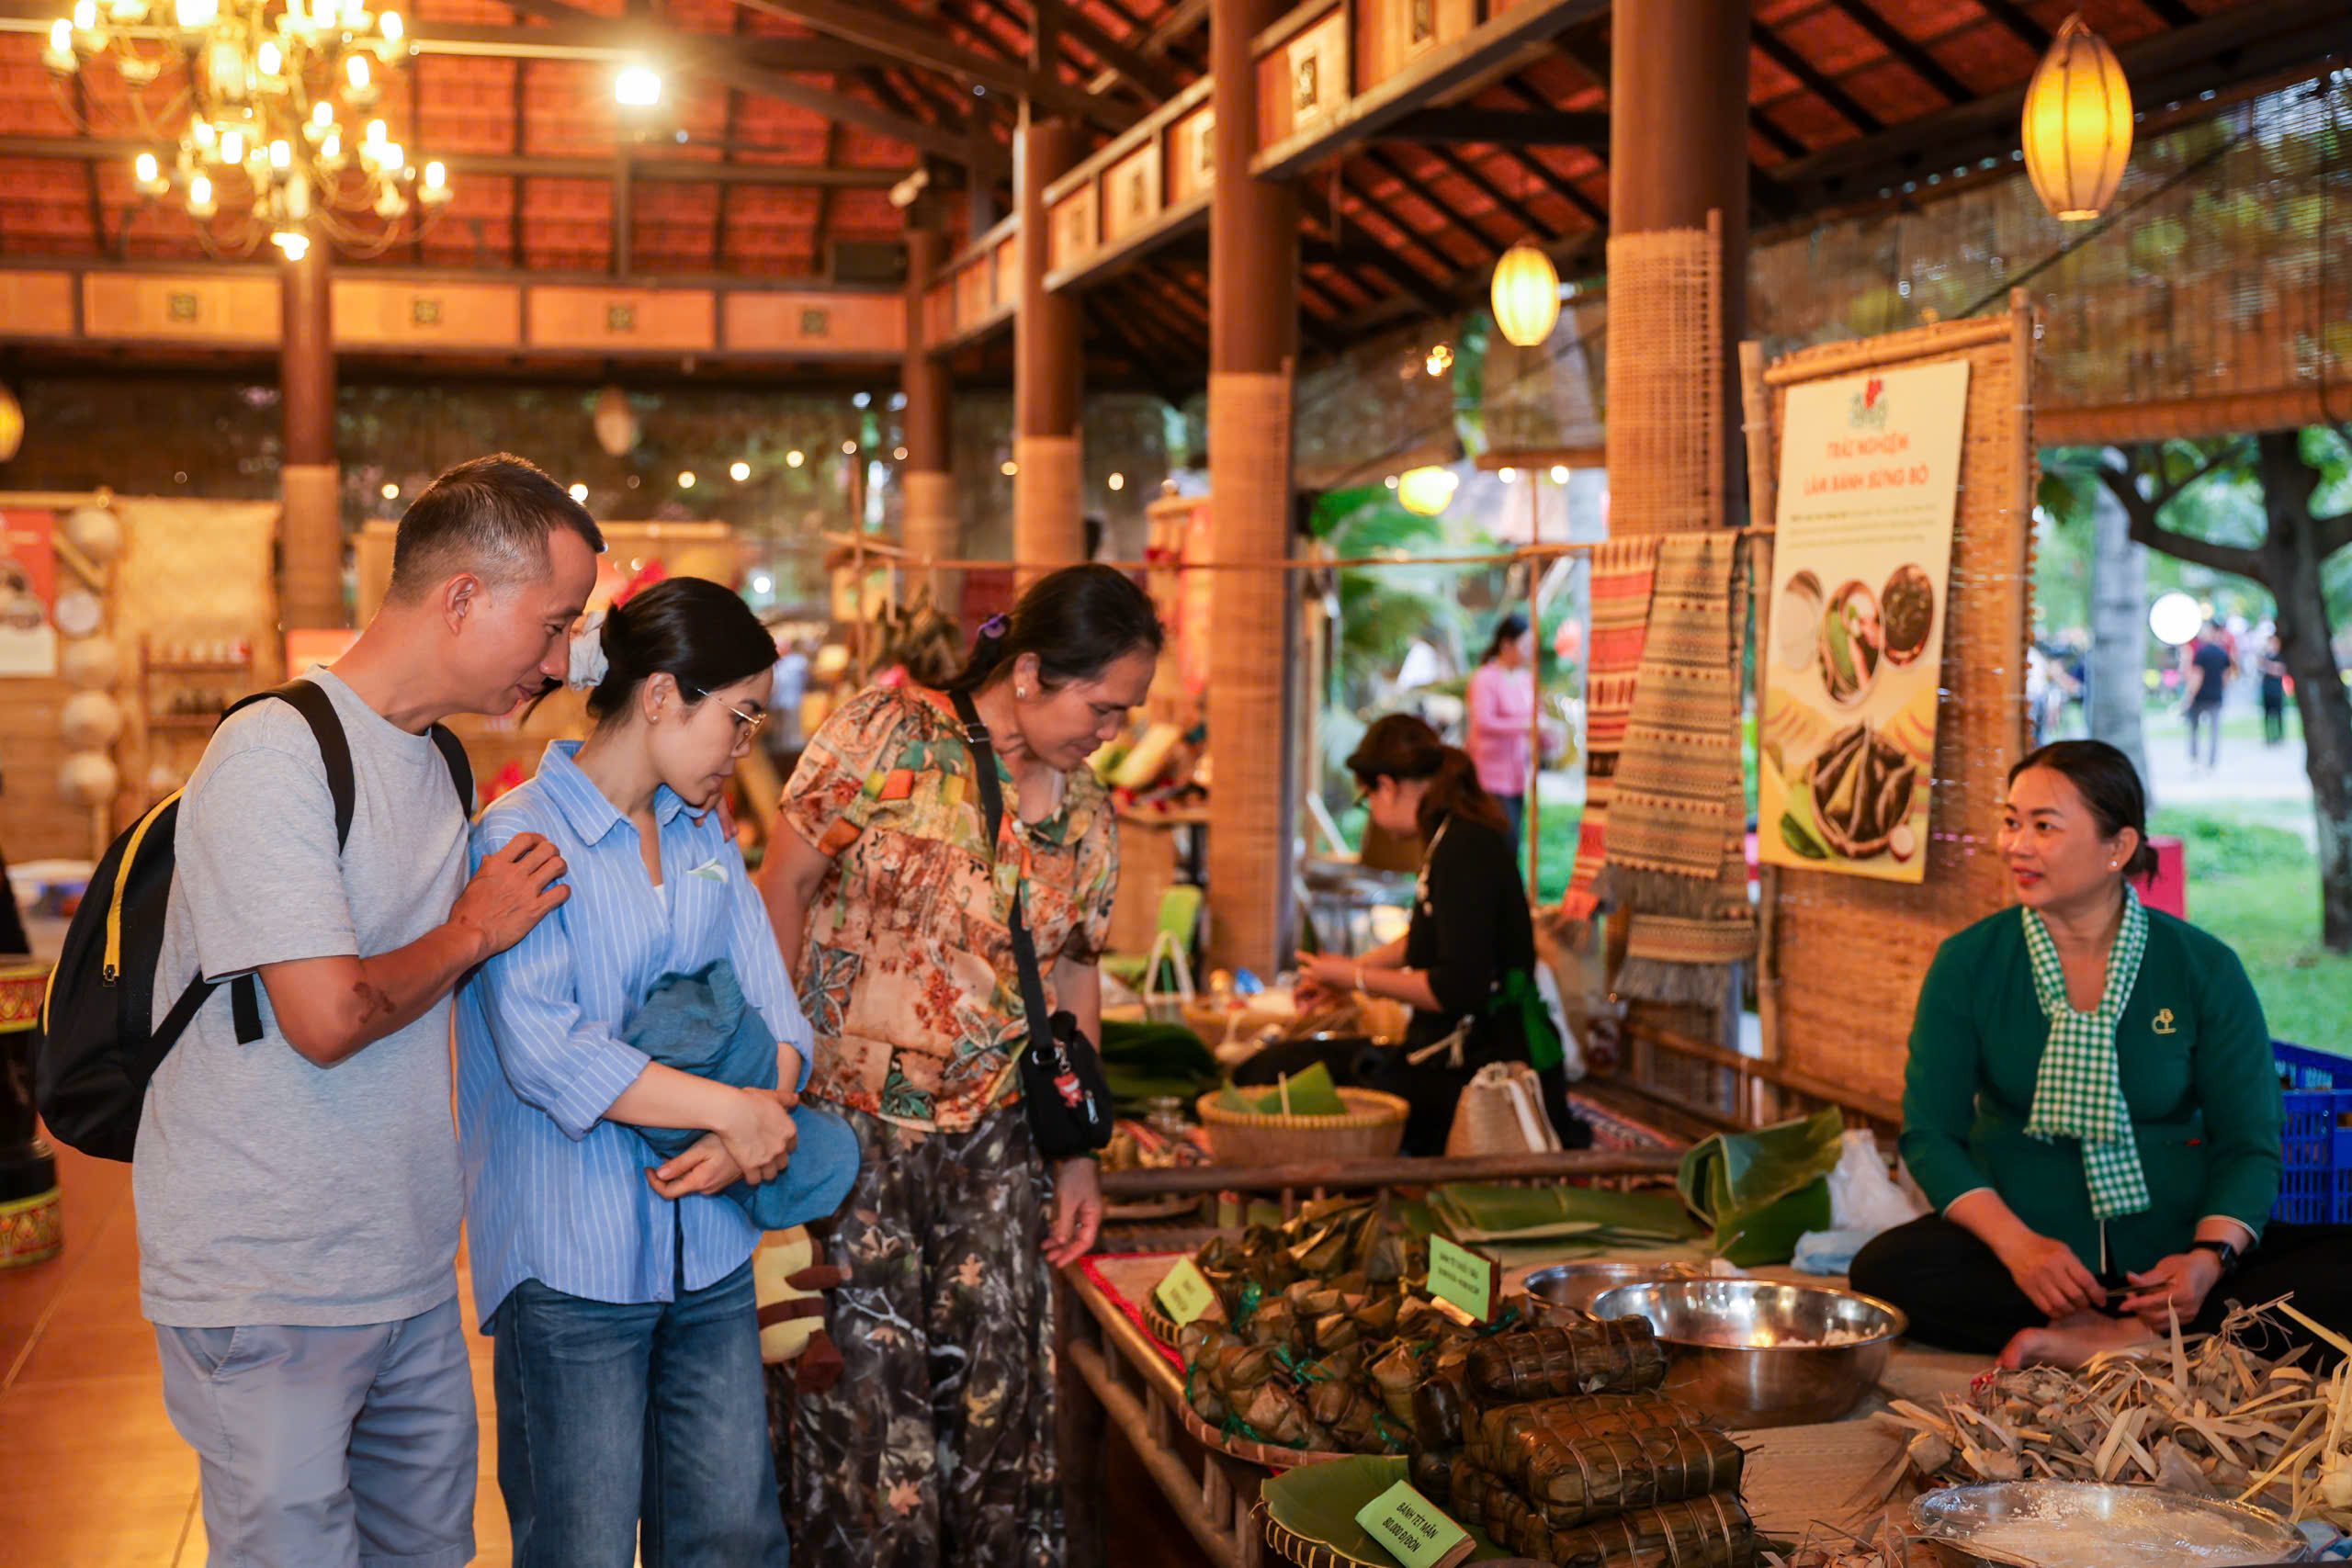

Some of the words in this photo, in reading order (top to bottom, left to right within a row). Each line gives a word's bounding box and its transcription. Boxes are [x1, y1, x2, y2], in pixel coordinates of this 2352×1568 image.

[1382, 1517, 1404, 1537] 80.000
[1396, 1502, 1416, 1521] BÁNH
[1419, 1524, 1439, 1540] MẶN
